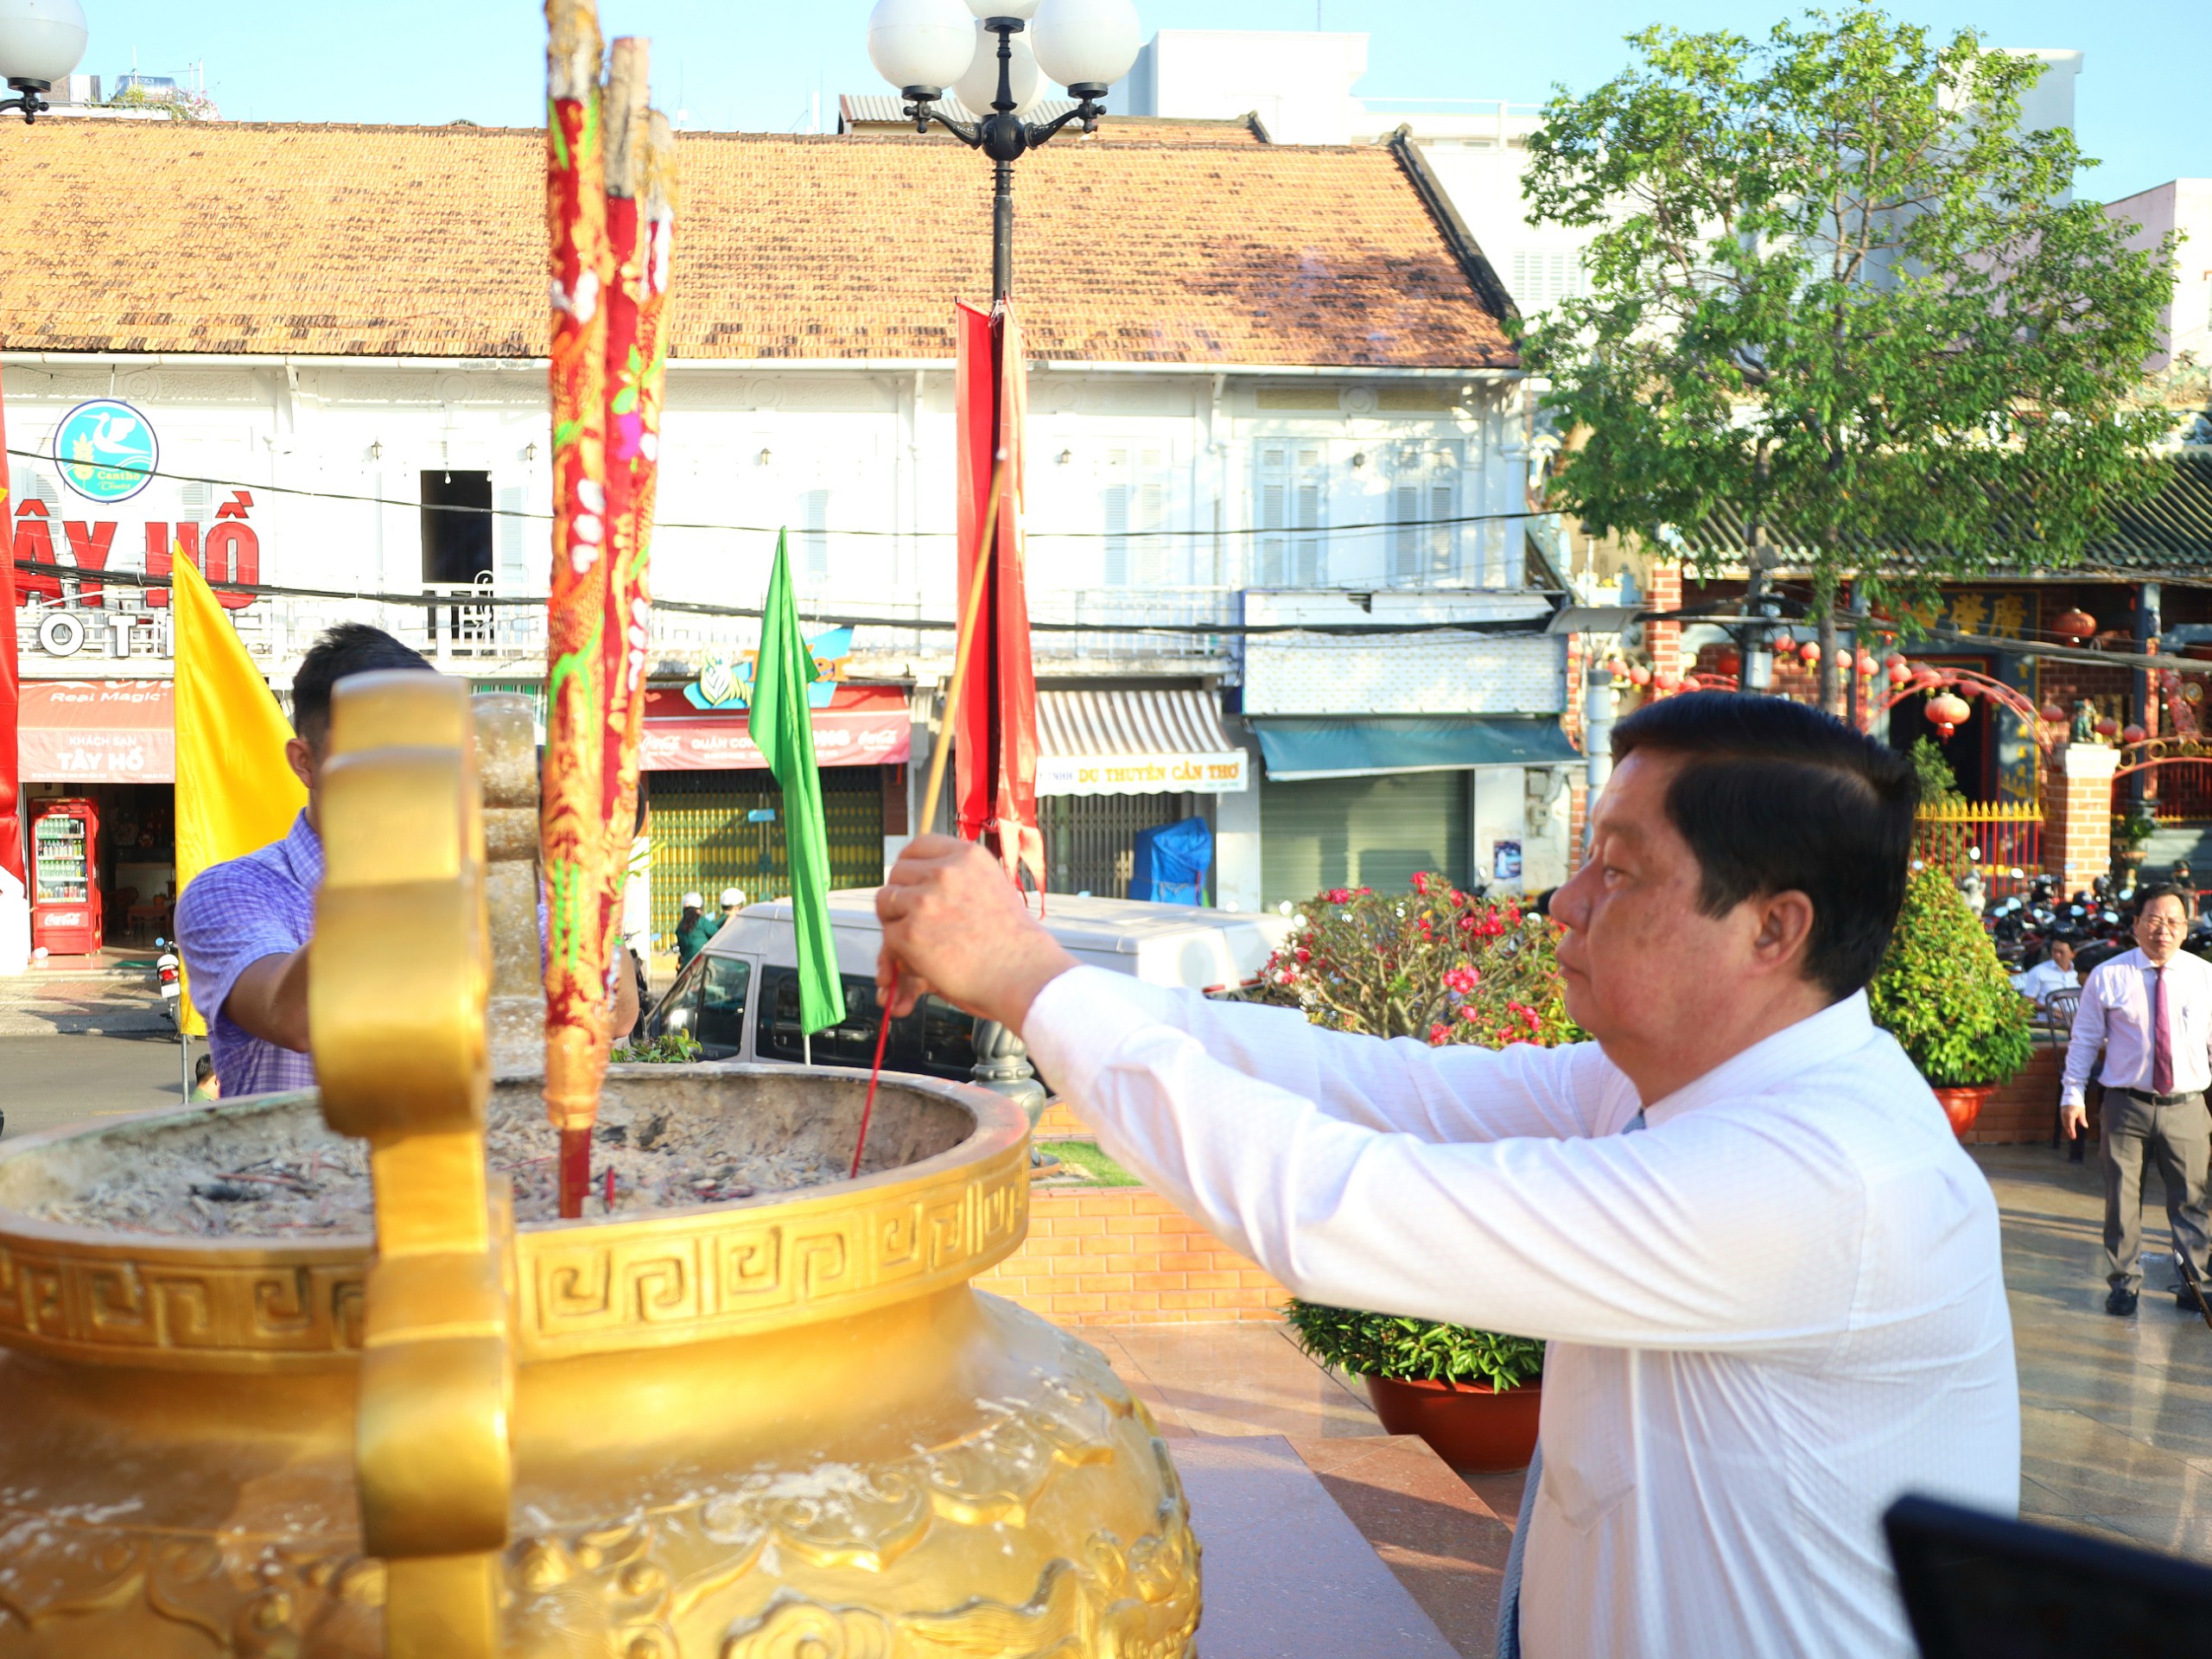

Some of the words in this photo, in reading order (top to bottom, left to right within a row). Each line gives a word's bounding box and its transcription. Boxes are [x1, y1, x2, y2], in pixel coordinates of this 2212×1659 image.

[14, 499, 118, 607] ÂY
[50, 692, 95, 702] Real
[56, 748, 103, 771] TÂY
